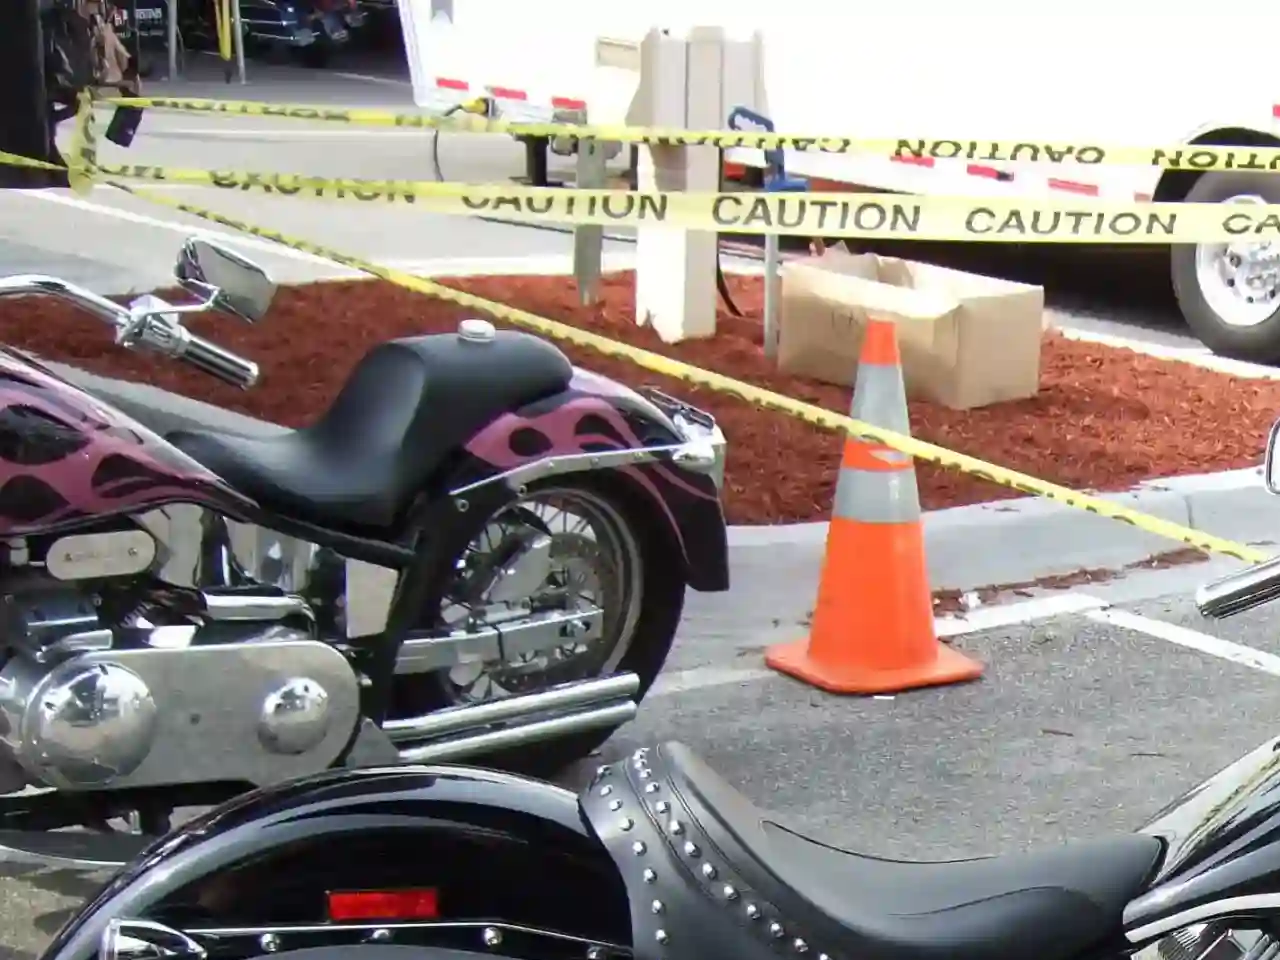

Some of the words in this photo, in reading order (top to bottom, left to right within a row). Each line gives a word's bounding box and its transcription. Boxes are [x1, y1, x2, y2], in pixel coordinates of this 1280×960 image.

[894, 138, 1106, 165] CAUTION
[712, 194, 921, 232] CAUTION
[965, 206, 1177, 236] CAUTION
